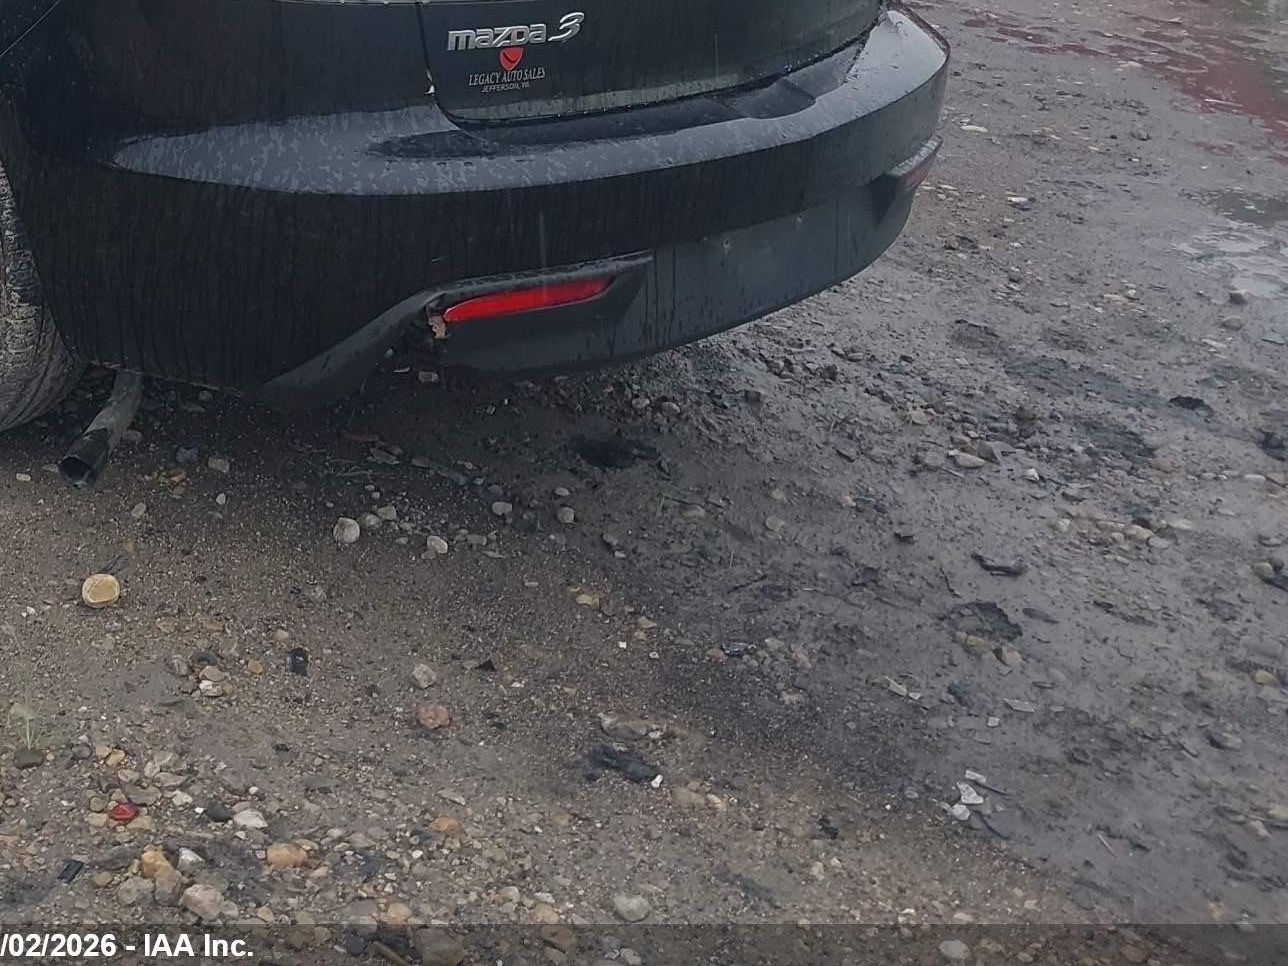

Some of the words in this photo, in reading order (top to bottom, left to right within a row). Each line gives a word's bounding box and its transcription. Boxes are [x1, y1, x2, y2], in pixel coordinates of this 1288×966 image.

[548, 11, 585, 43] 3
[469, 72, 501, 86] LEGACY
[501, 69, 523, 83] AUTO
[523, 67, 546, 81] SALES
